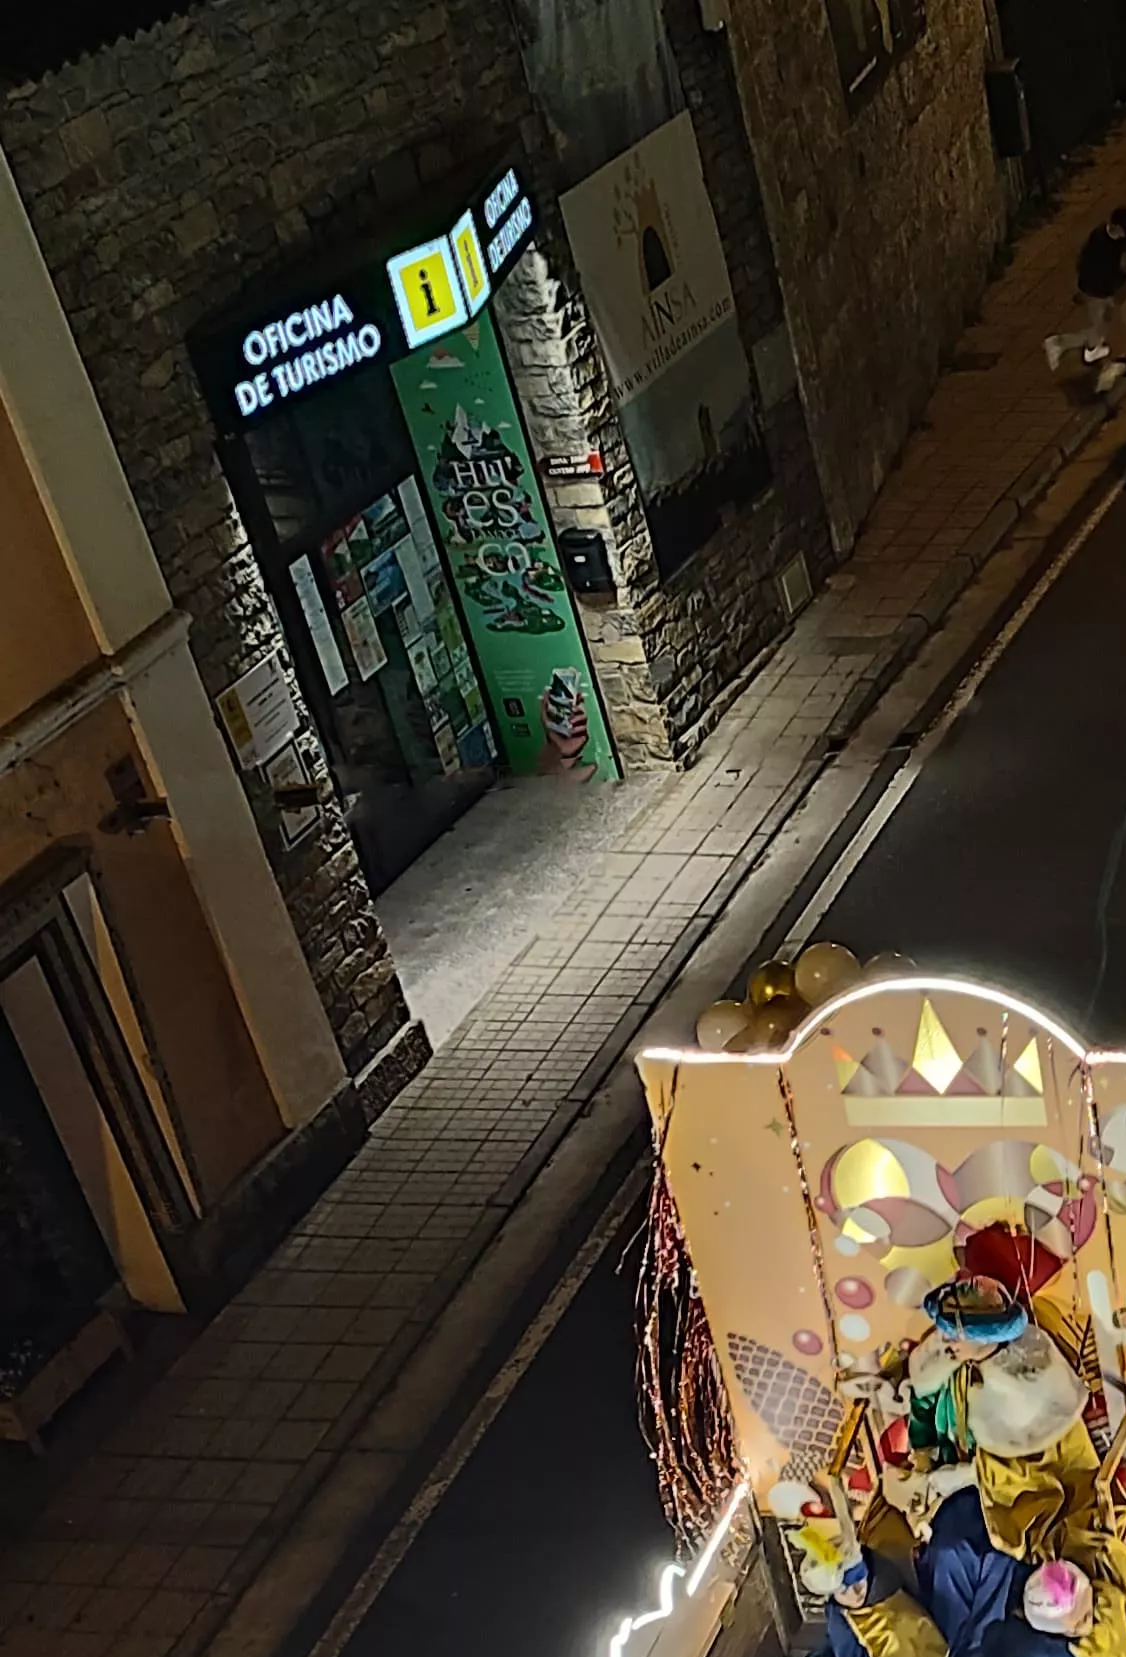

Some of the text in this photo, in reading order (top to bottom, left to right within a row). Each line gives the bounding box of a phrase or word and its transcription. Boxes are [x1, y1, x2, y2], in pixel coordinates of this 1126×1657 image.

[484, 168, 519, 229] OFICINA
[243, 294, 354, 365] OFICINA
[235, 323, 381, 416] DE TURISMO
